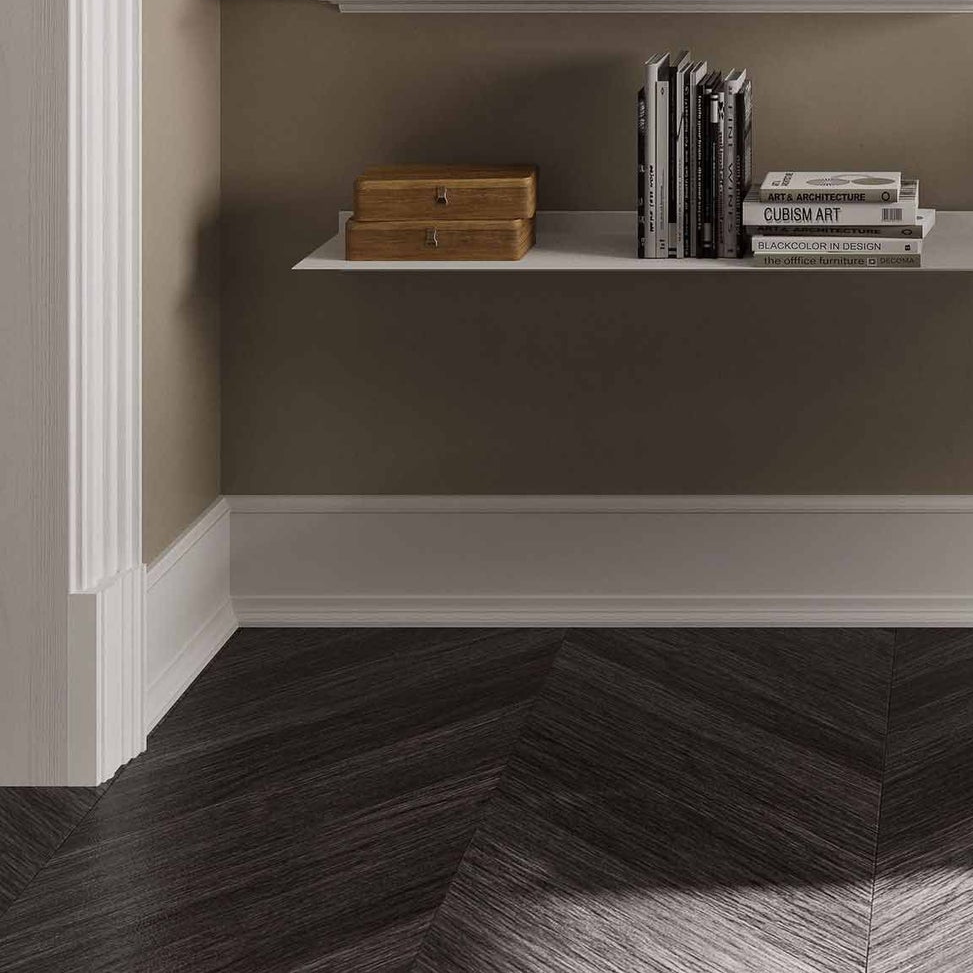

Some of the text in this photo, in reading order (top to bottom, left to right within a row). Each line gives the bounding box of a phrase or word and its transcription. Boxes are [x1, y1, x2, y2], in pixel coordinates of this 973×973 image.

[768, 193, 787, 201] ART
[797, 193, 866, 201] ARCHITECTURE
[764, 207, 841, 221] CUBISM ART
[758, 242, 881, 250] BLACKCOLOR IN DESIGN
[764, 256, 783, 265] the
[819, 256, 864, 265] furniture
